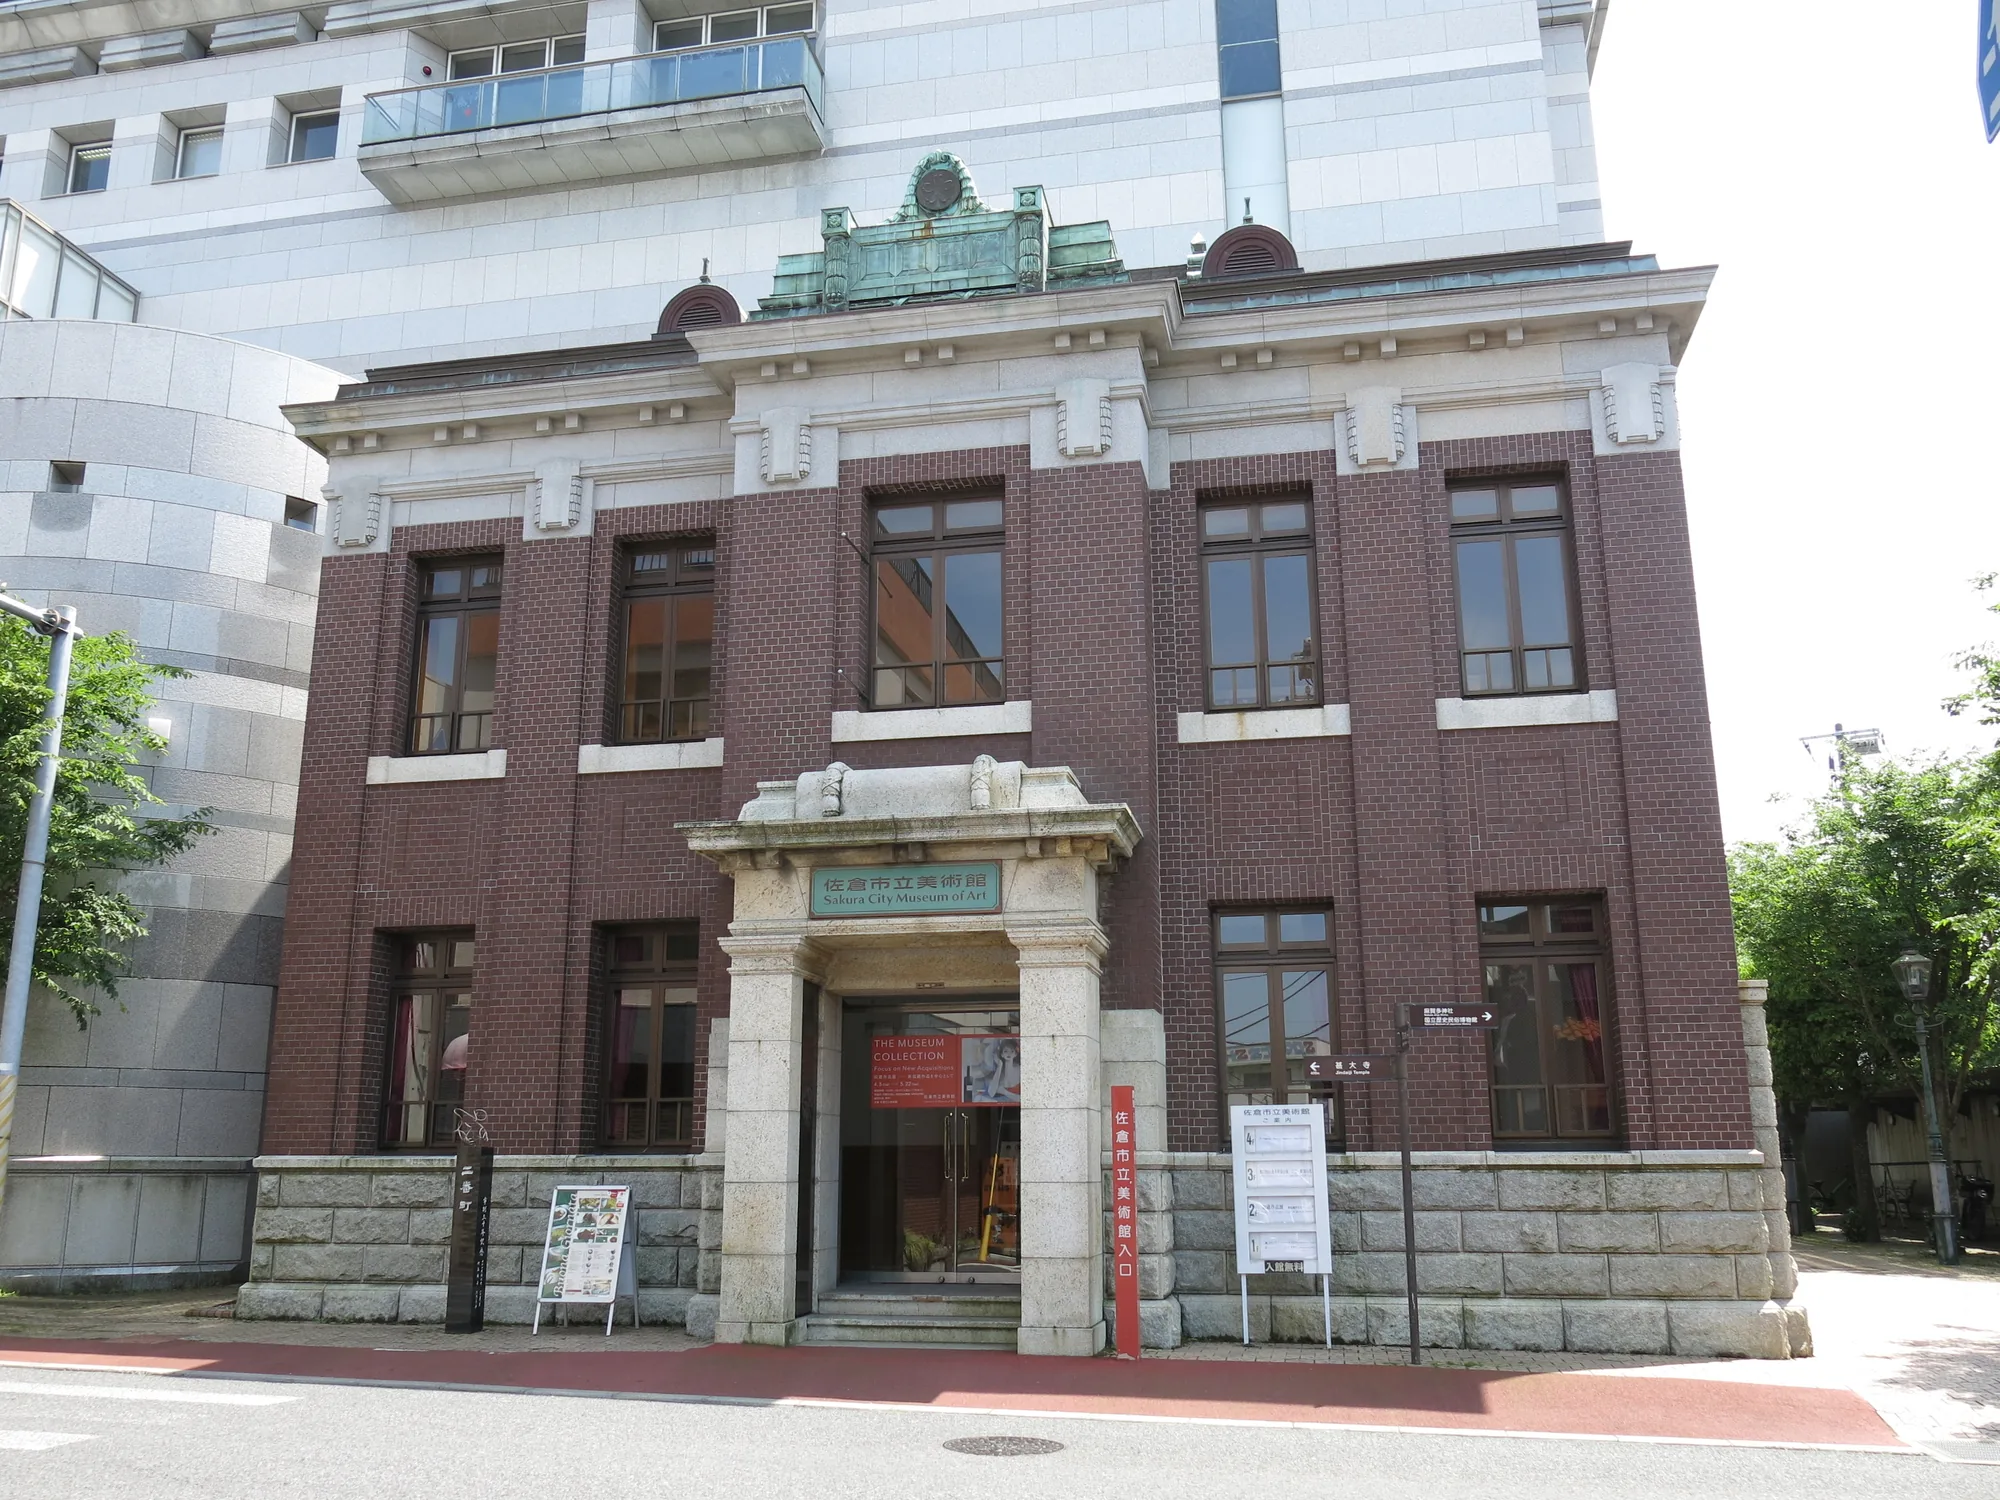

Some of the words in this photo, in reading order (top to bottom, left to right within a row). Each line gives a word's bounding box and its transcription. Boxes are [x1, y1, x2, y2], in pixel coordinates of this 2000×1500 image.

[824, 873, 987, 892] 佐倉市立美術館
[824, 894, 865, 905] Sakura
[868, 893, 893, 906] City
[896, 893, 949, 903] Museum
[952, 891, 965, 901] of
[967, 890, 987, 901] Art
[898, 1039, 944, 1047] MUSEUM
[874, 1052, 944, 1060] COLLECTION
[1244, 1108, 1310, 1116] 佐倉市立美術館
[459, 1166, 473, 1211] 二番町
[1115, 1111, 1132, 1276] 佐倉市立美術館入口
[1265, 1262, 1304, 1272] 入館無料
[553, 1254, 569, 1297] Buona
